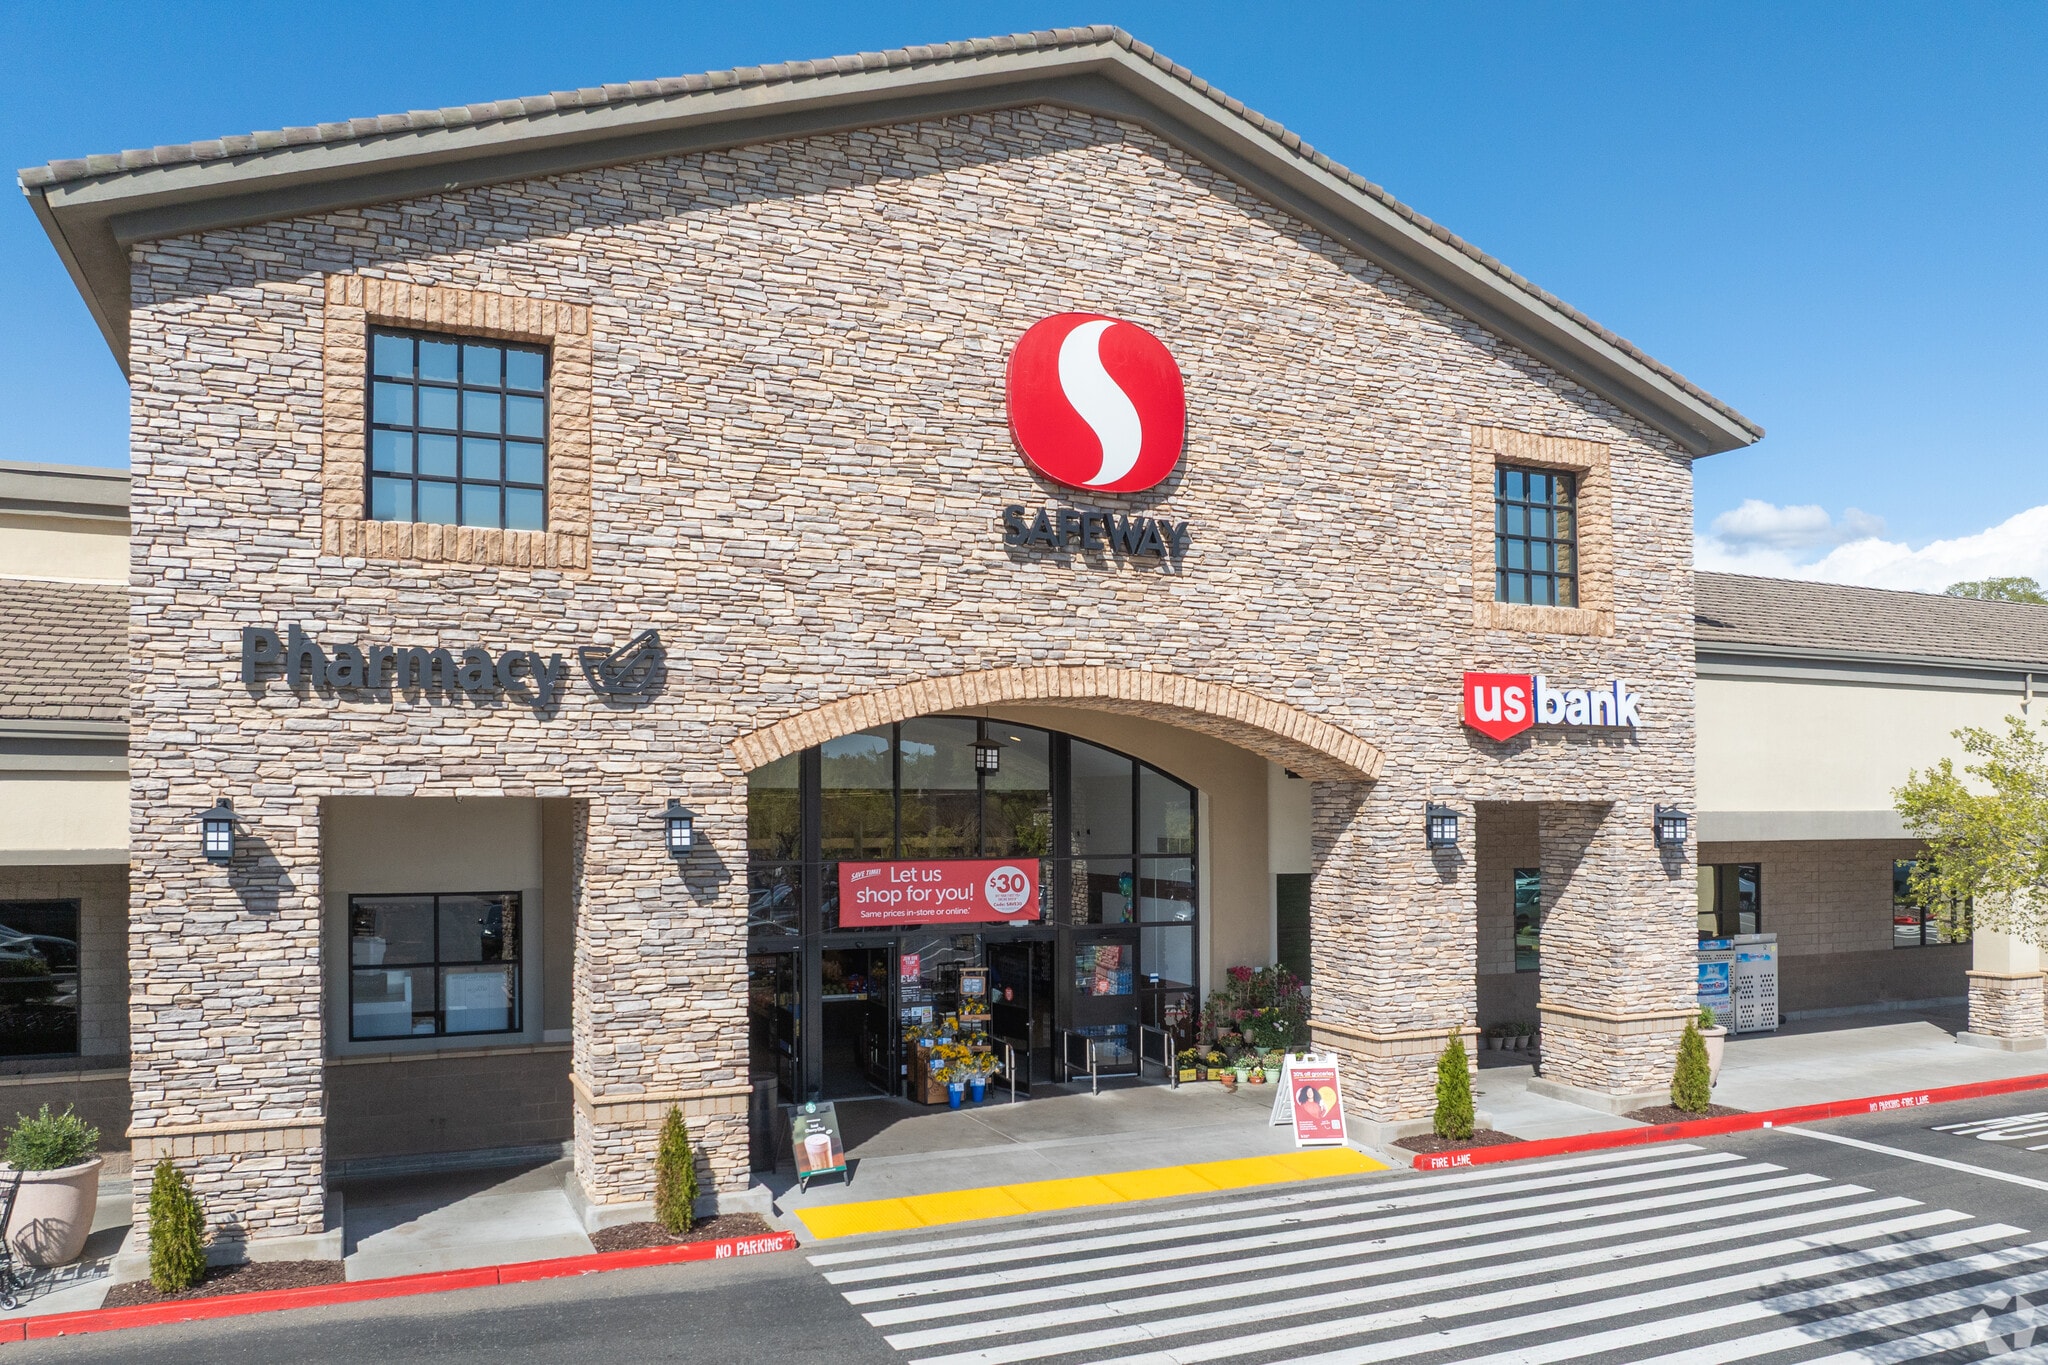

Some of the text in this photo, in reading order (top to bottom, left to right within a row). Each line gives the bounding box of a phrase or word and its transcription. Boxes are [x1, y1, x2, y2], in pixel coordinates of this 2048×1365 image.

[1003, 504, 1189, 557] SAFEWAY
[241, 623, 562, 707] Pharmacy
[1473, 675, 1642, 727] us bank
[890, 866, 942, 883] Let us
[990, 873, 1026, 893] $30
[856, 883, 974, 906] shop for you!
[860, 911, 882, 919] Same
[883, 909, 905, 919] prices
[906, 908, 935, 917] in-store
[1869, 1102, 1878, 1112] NO
[1879, 1099, 1900, 1111] PARKING
[1915, 1094, 1930, 1106] LANE
[1431, 1153, 1473, 1169] FIRE LANE
[715, 1237, 783, 1259] NO PARKING
